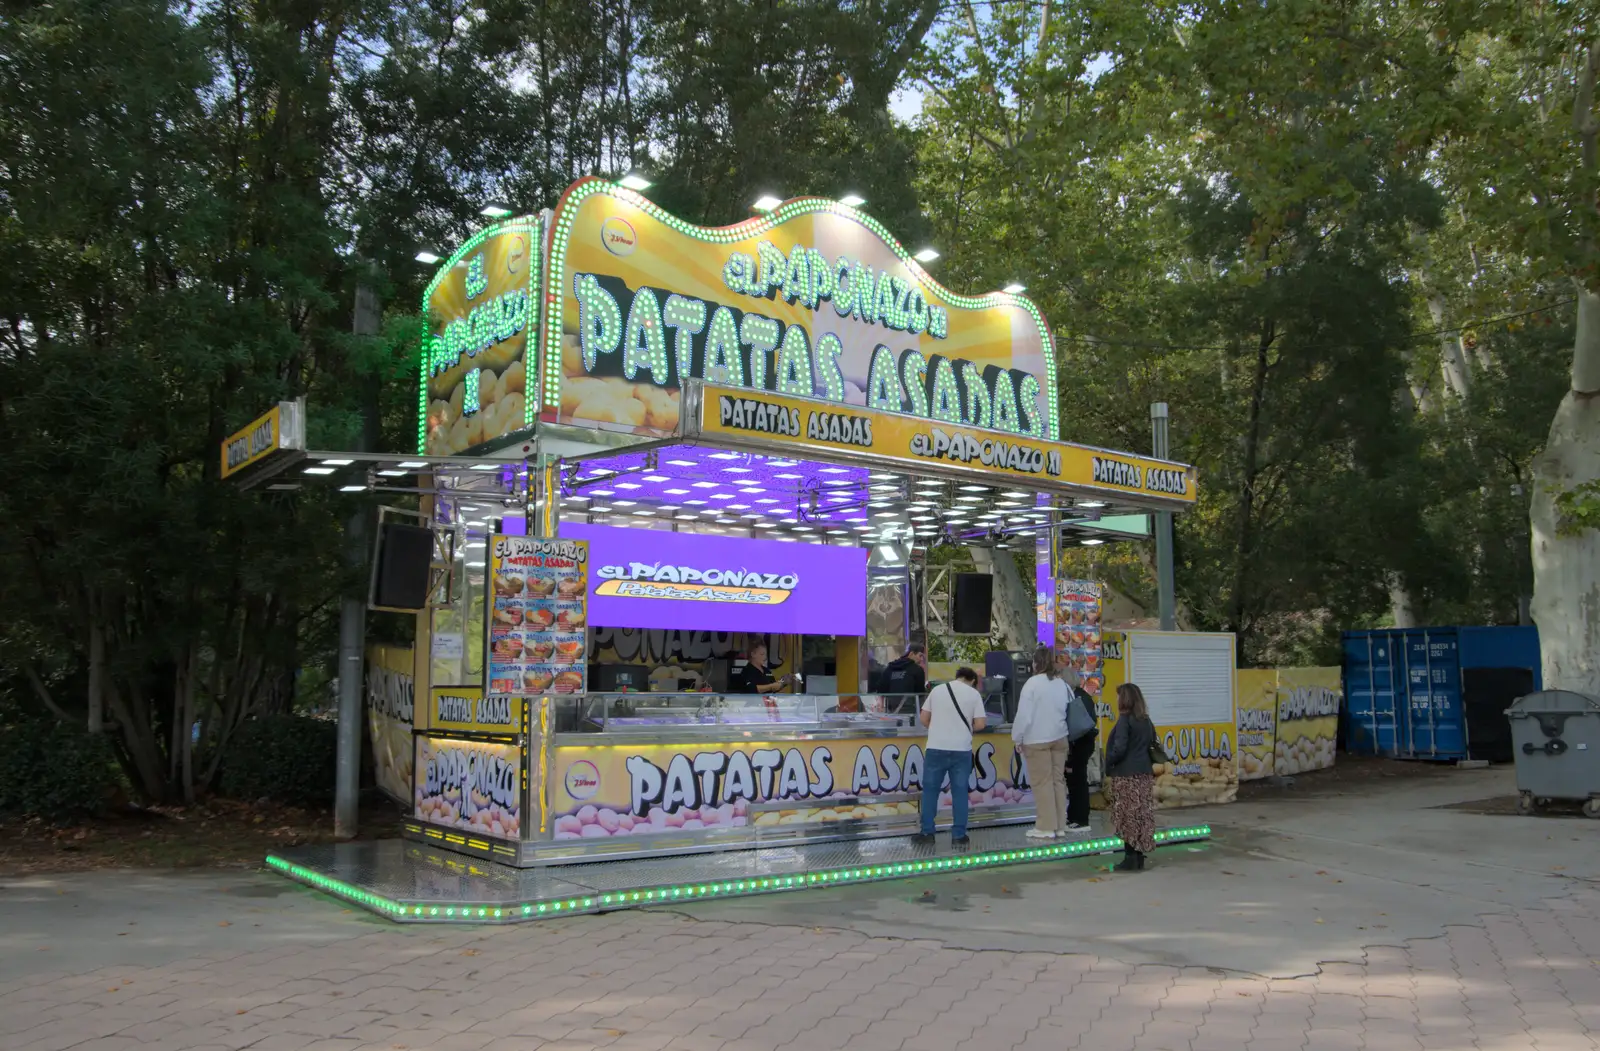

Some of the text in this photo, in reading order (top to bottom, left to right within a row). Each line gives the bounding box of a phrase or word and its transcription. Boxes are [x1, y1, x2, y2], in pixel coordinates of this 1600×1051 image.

[723, 251, 759, 297] EL
[757, 239, 929, 334] PAPONAZO
[573, 272, 1043, 441] PATATAS ASADAS
[719, 394, 1188, 495] PATATAS ASADAS EL PAPONAZO XI PATATAS ASADAS
[494, 539, 587, 564] EL PAPONAZO
[596, 561, 800, 591] EL PAPONAZO
[617, 580, 772, 604] Patatas Asadas
[438, 695, 512, 725] PATATAS ASADAS
[1156, 727, 1232, 766] QUILLA
[437, 748, 516, 809] PAPONAZO
[625, 746, 833, 818] PATATAS
[851, 743, 997, 797] ASAS
